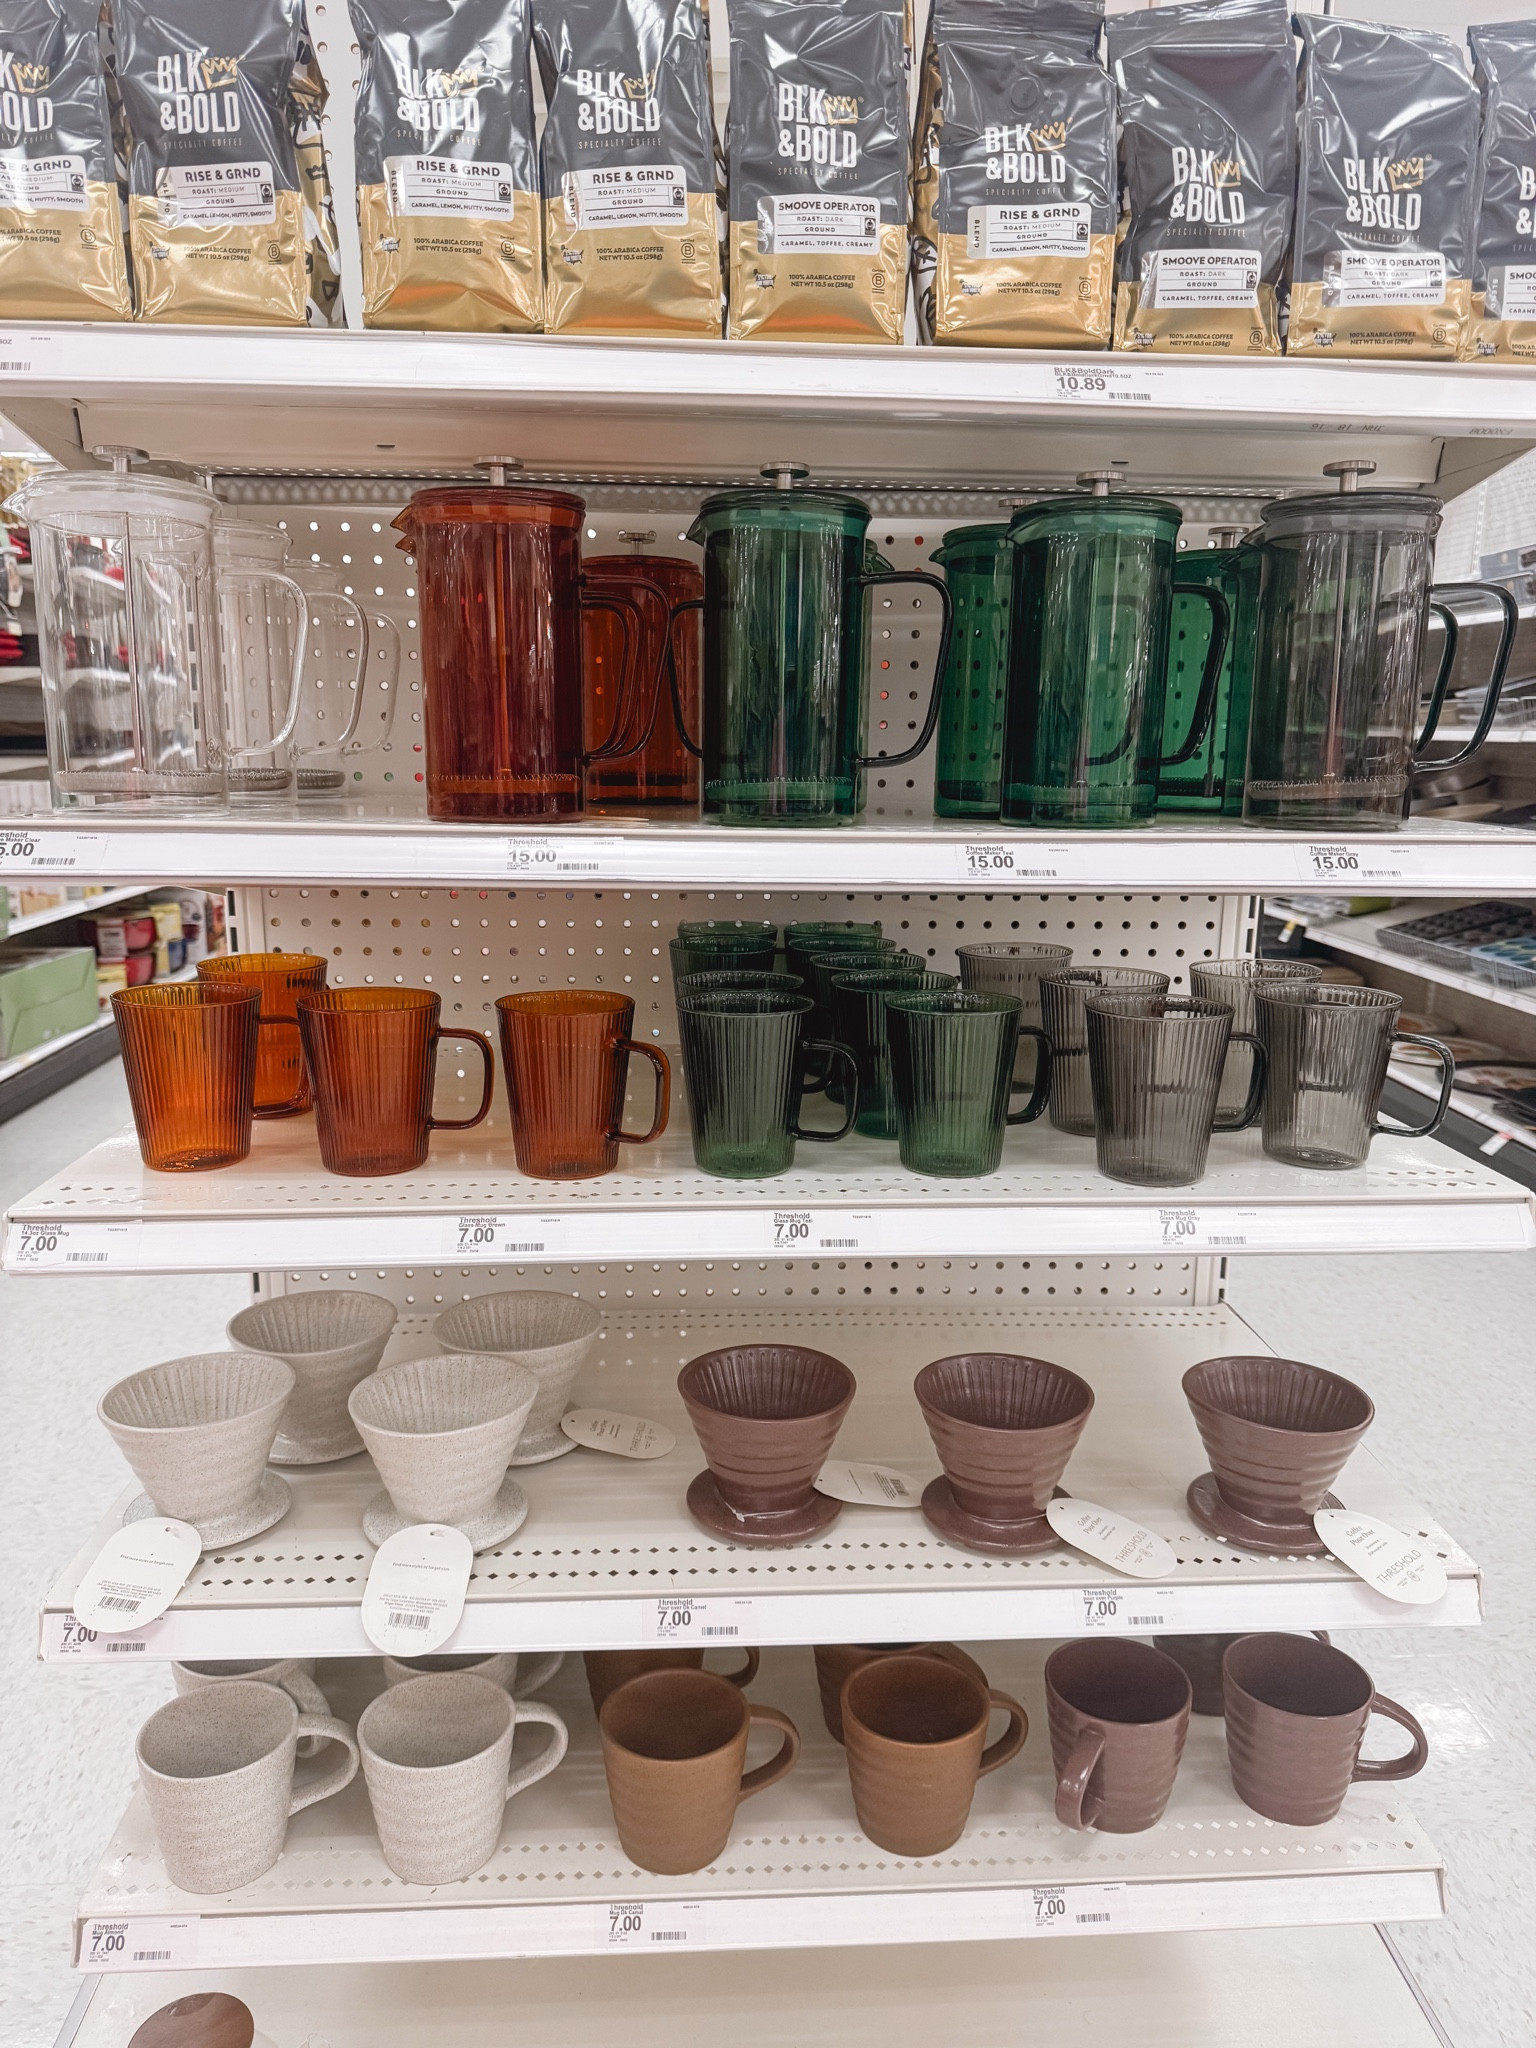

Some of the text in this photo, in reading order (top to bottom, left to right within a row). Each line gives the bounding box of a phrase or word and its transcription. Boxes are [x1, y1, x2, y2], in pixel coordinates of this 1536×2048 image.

[158, 51, 205, 94] BLK
[397, 60, 445, 99] BLK
[577, 69, 626, 98] BLK
[779, 83, 827, 125] BLK
[160, 91, 241, 134] &BOLD
[397, 97, 480, 132] &BOLD
[577, 97, 660, 134] &BOLD
[450, 134, 482, 146] COFFEE
[578, 138, 662, 150] SPECIALTY COFFEE
[985, 122, 1033, 153] BLK
[778, 124, 857, 168] &BOLD
[34, 160, 72, 171] GRND
[417, 160, 500, 177] RISE & GRND
[985, 152, 1066, 183] &BOLD
[1172, 147, 1215, 187] BLK
[185, 168, 260, 182] RISE & GRND
[593, 170, 674, 184] RISE & GRND
[1343, 156, 1390, 194] BLK
[436, 188, 469, 196] GROUND
[568, 185, 576, 218] BLEND
[612, 198, 644, 206] GROUND
[779, 201, 875, 212] SMOOVE OPERATOR
[1170, 183, 1246, 224] &BOLD
[1000, 208, 1080, 220] RISE & GRND
[1345, 193, 1421, 231] &BOLD
[1166, 227, 1246, 237] SPECIALTY COFFEE
[459, 239, 483, 247] COFFEE
[1162, 256, 1258, 266] SMOOVE OPERATOR
[1346, 256, 1440, 267] SMOOVE OPERATOR
[1056, 376, 1106, 391] 10.89
[0, 842, 35, 856] 5.00
[508, 849, 557, 862] 15.00
[967, 855, 1014, 868] 15.00
[1312, 856, 1359, 869] 15.00
[458, 1227, 495, 1243] 7.00
[774, 1223, 809, 1238] 7.00
[1160, 1220, 1196, 1235] 7.00
[20, 1235, 58, 1251] 7.00
[1115, 1530, 1147, 1562] THRESHOLD
[1376, 1549, 1421, 1584] THRESHOLD
[1084, 1600, 1117, 1616] 7.00
[658, 1610, 692, 1626] 7.00
[63, 1626, 98, 1642] 7.00
[1032, 1887, 1065, 1895] Threshold
[1034, 1899, 1066, 1916] 7.00
[609, 1915, 641, 1931] 7.00
[91, 1935, 125, 1951] 7.00
